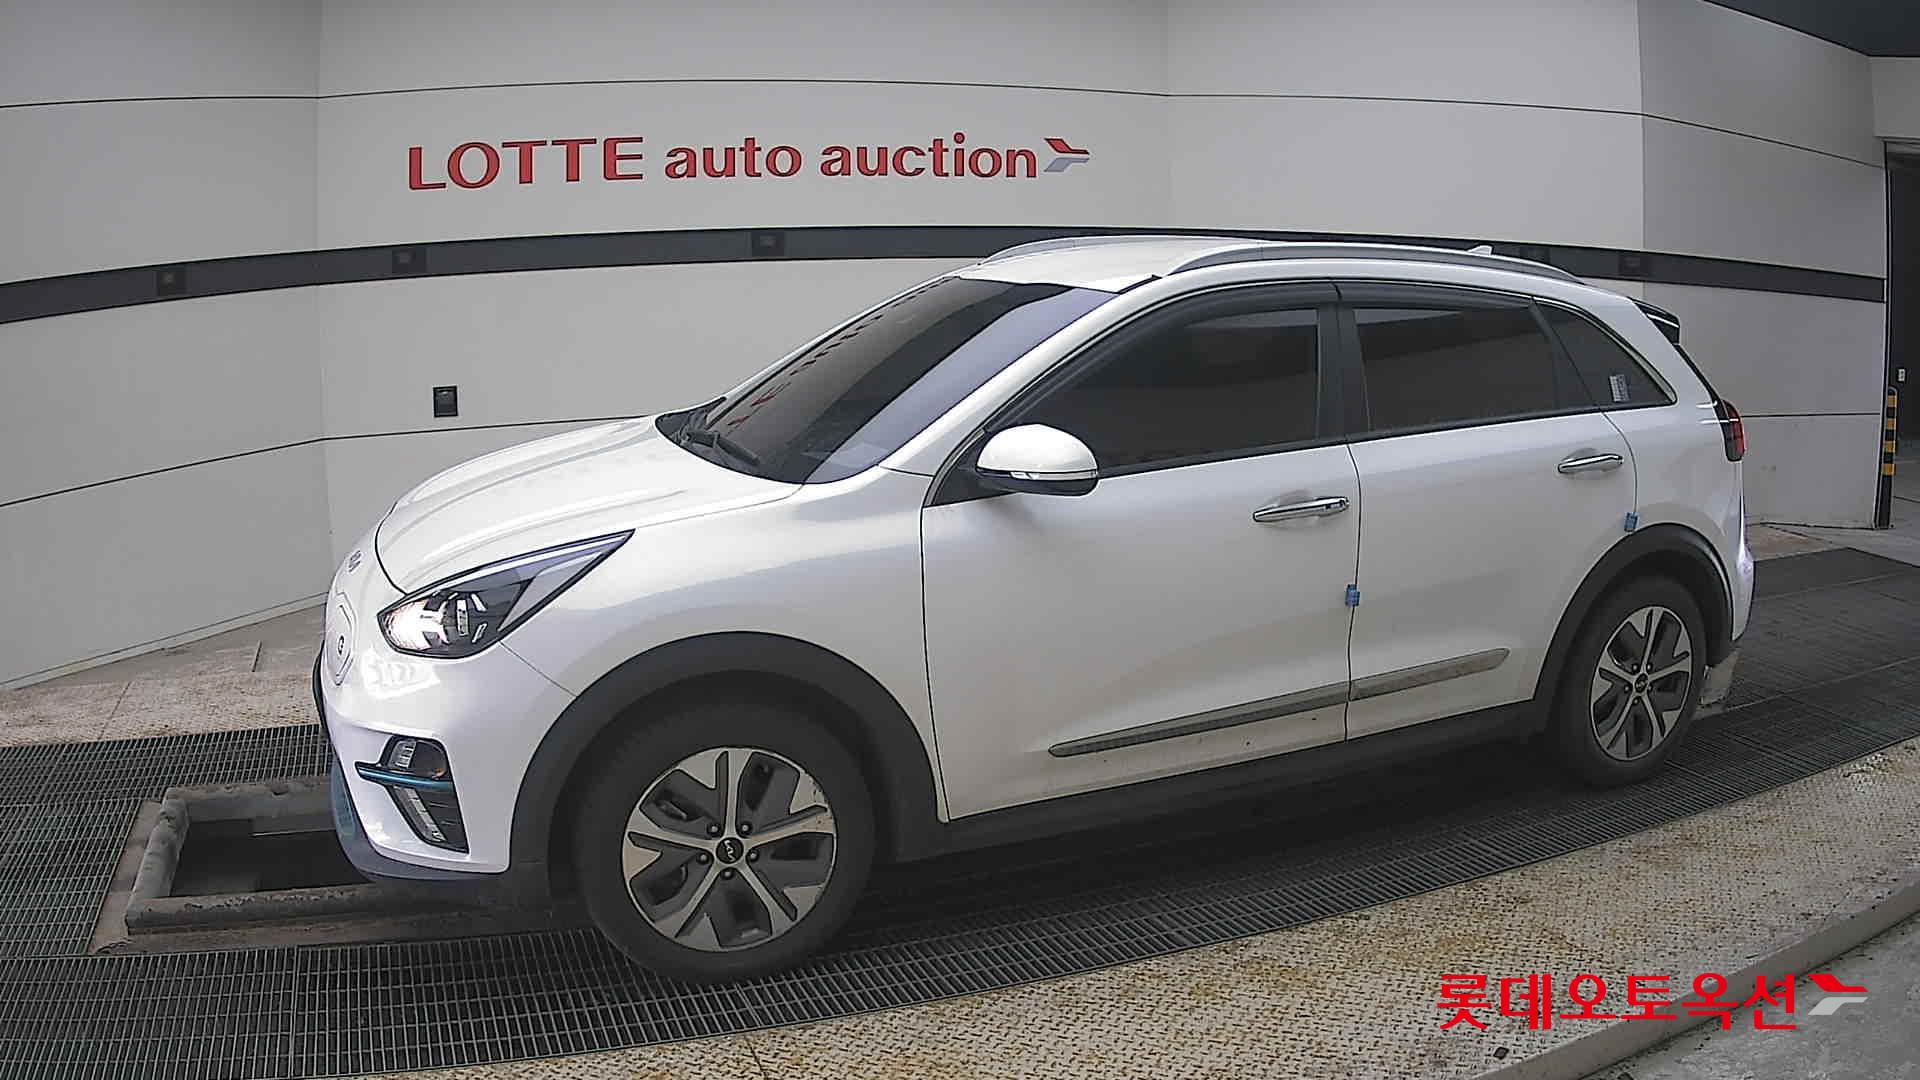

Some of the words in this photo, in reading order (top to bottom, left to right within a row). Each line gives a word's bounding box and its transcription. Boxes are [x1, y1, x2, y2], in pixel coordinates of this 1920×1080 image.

[408, 135, 643, 190] LOTTE
[664, 136, 803, 178] auto
[819, 132, 1038, 178] auction
